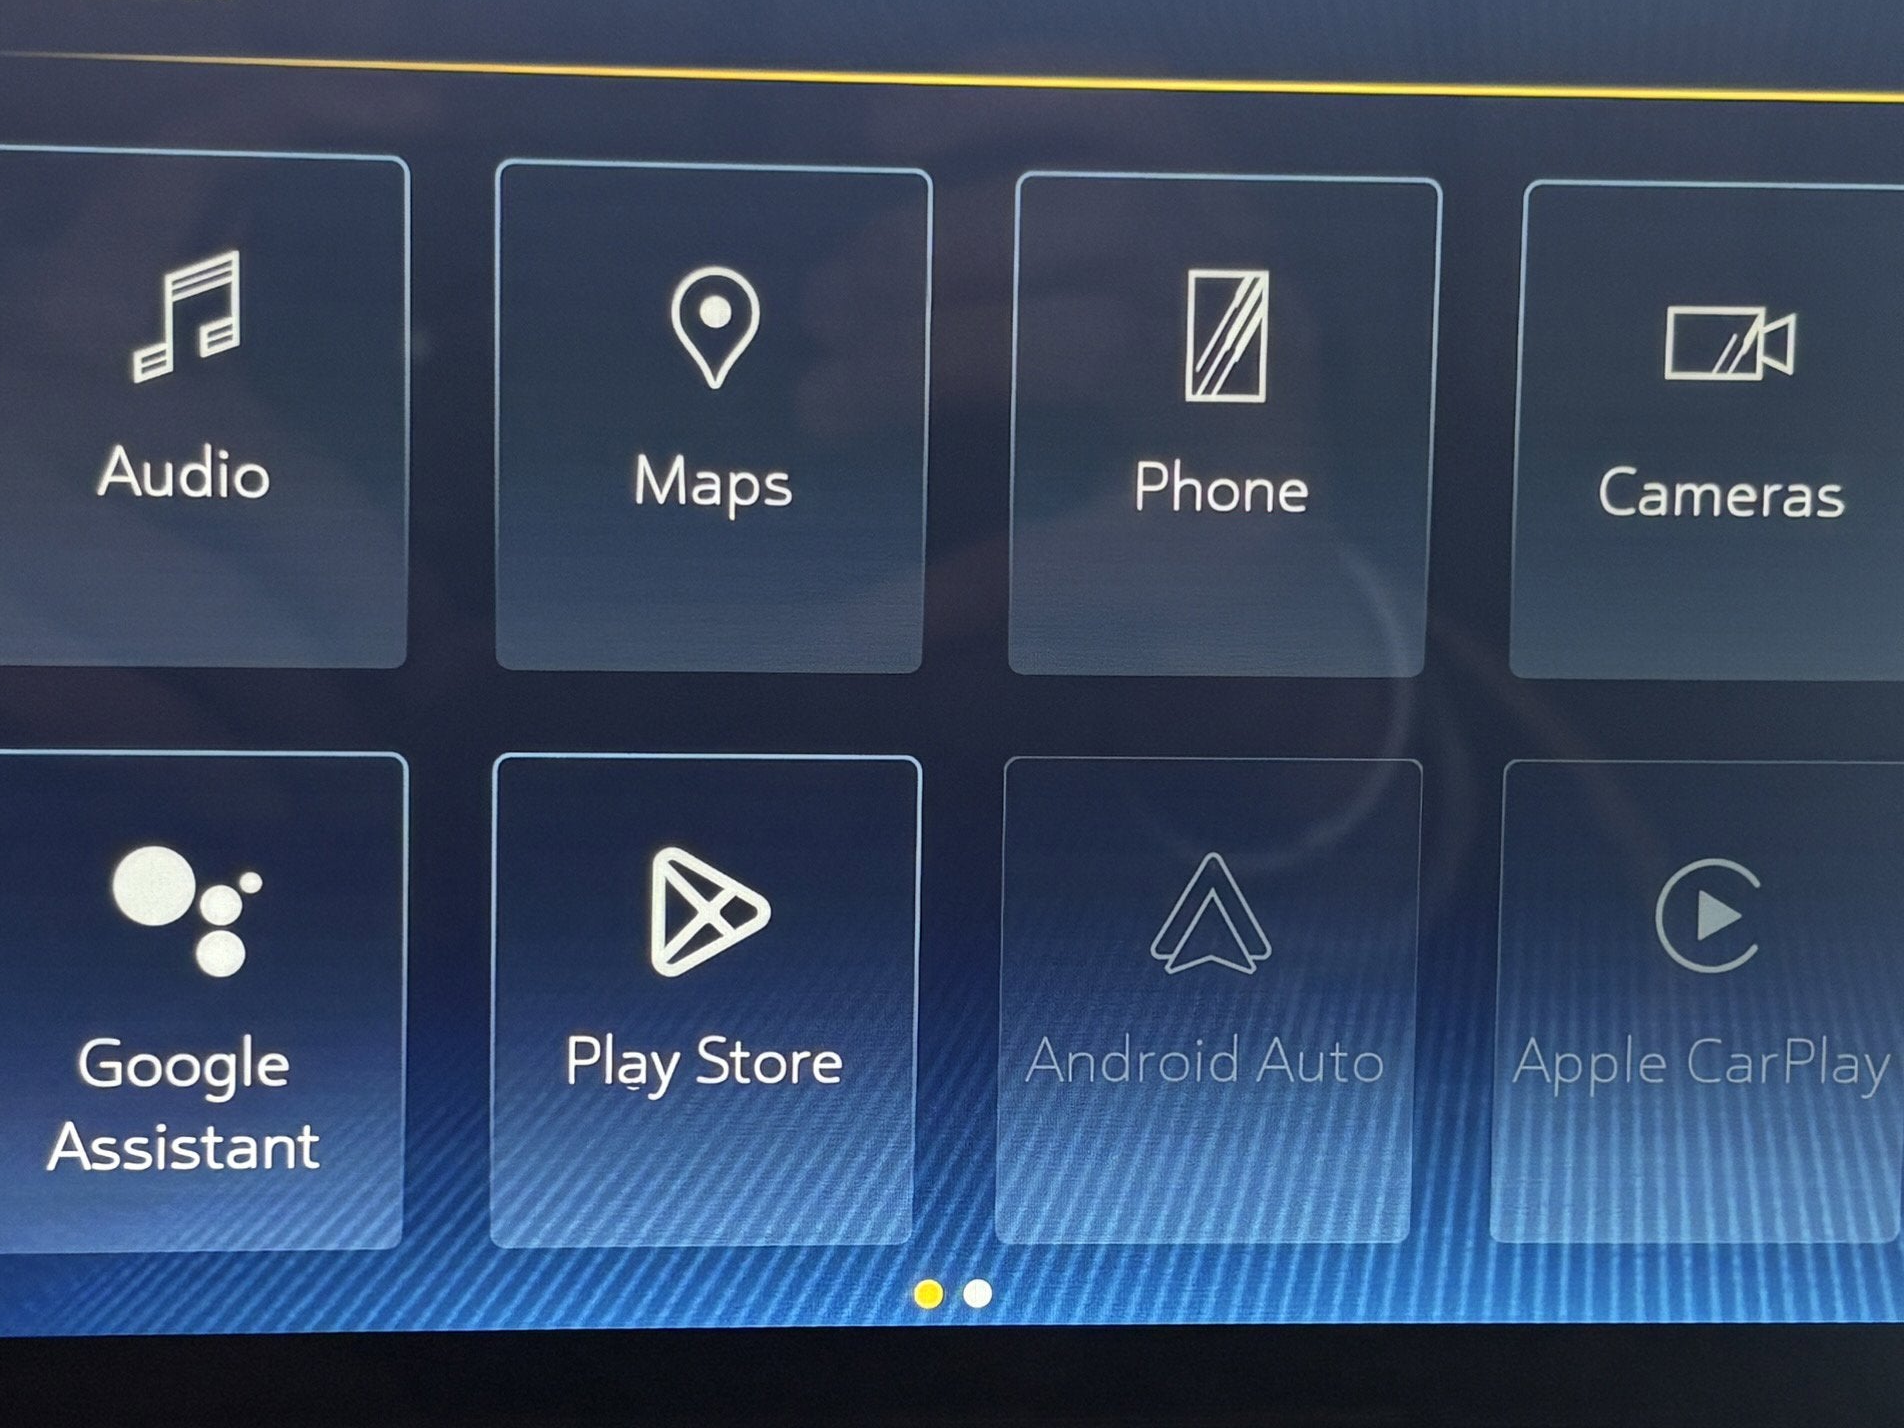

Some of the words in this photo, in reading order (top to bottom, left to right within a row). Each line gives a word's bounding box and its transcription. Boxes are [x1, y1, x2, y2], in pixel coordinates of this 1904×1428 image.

[95, 443, 271, 499] Audio
[634, 454, 794, 520] Maps
[1134, 460, 1309, 514] Phone
[1599, 466, 1846, 519] Cameras
[76, 1035, 291, 1104] Google
[566, 1034, 681, 1101] Play
[696, 1035, 843, 1086] Store
[1025, 1034, 1240, 1085] Android
[1256, 1035, 1385, 1085] Auto
[1512, 1035, 1666, 1097] Apple
[1687, 1035, 1893, 1101] CarPlay
[46, 1121, 321, 1172] Assistant
